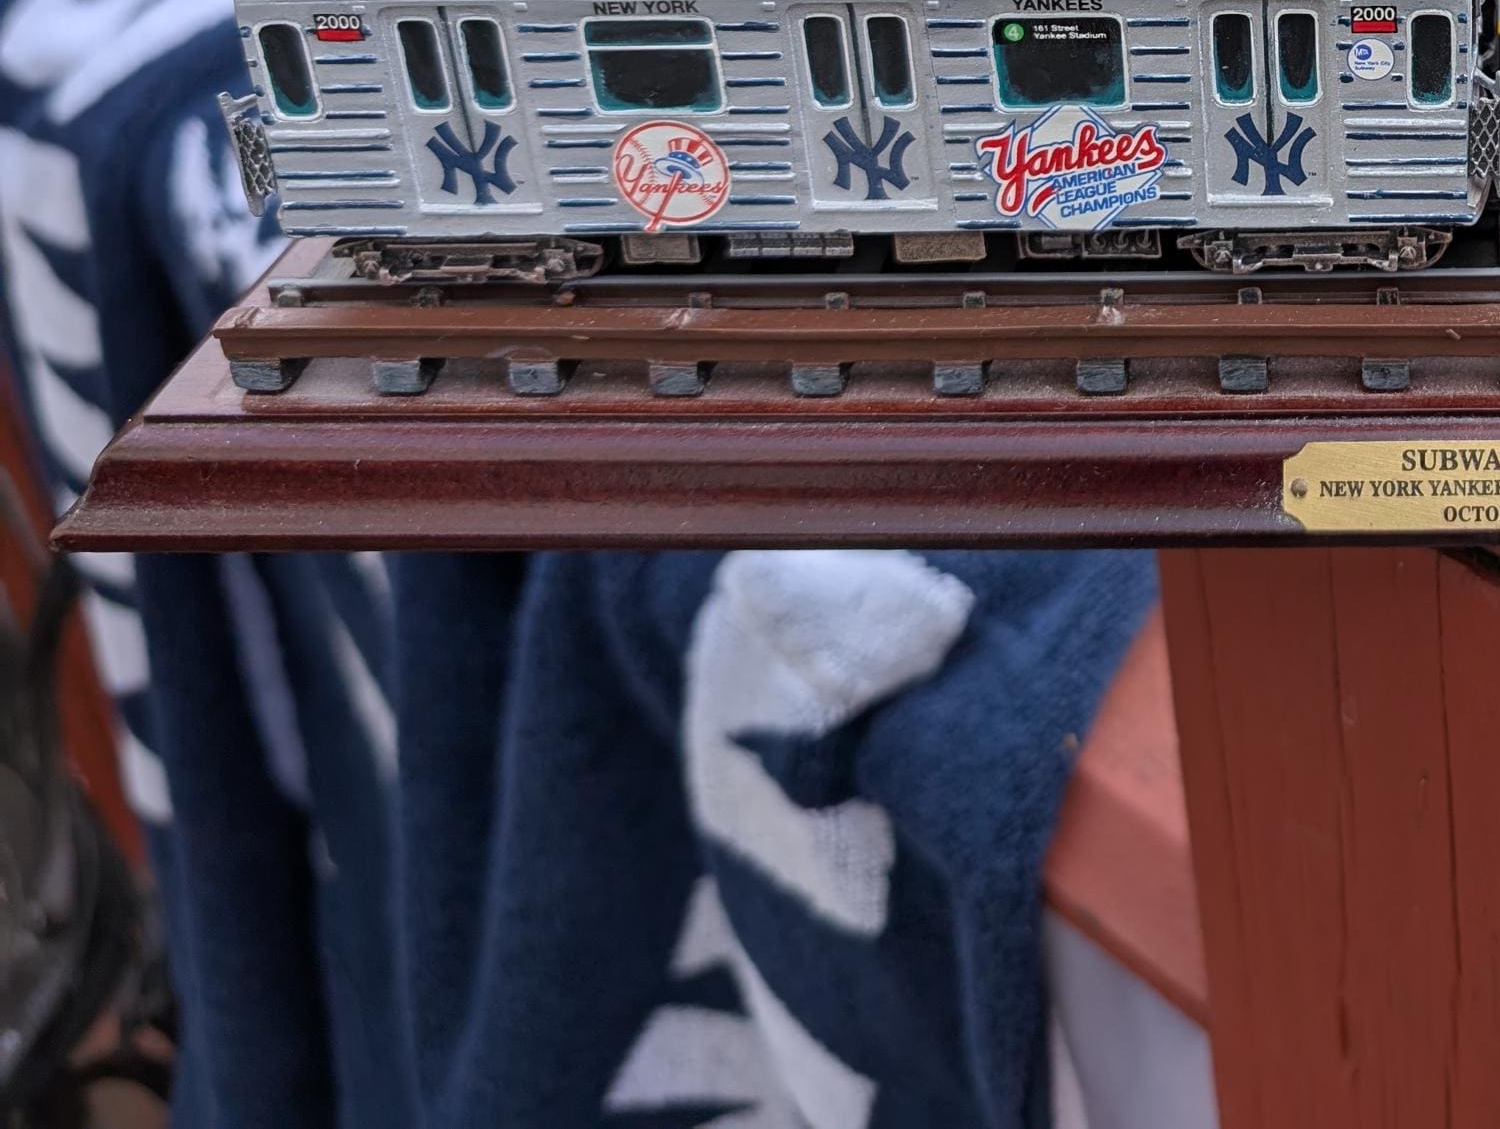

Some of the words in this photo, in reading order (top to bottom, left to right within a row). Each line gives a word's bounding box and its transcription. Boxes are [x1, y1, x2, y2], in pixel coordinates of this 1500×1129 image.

[593, 2, 636, 15] NEW
[643, 0, 699, 14] YORK
[1353, 7, 1396, 21] 2000
[316, 15, 361, 30] 2000
[1069, 31, 1107, 39] Stadium
[616, 154, 727, 196] Yankees
[974, 124, 1166, 215] Yankees
[1051, 163, 1136, 191] AMERICAN
[1056, 181, 1117, 205] LEAGUE
[1060, 186, 1157, 218] CHAMPIONS
[1319, 480, 1364, 497] NEW
[1369, 479, 1424, 497] YORK
